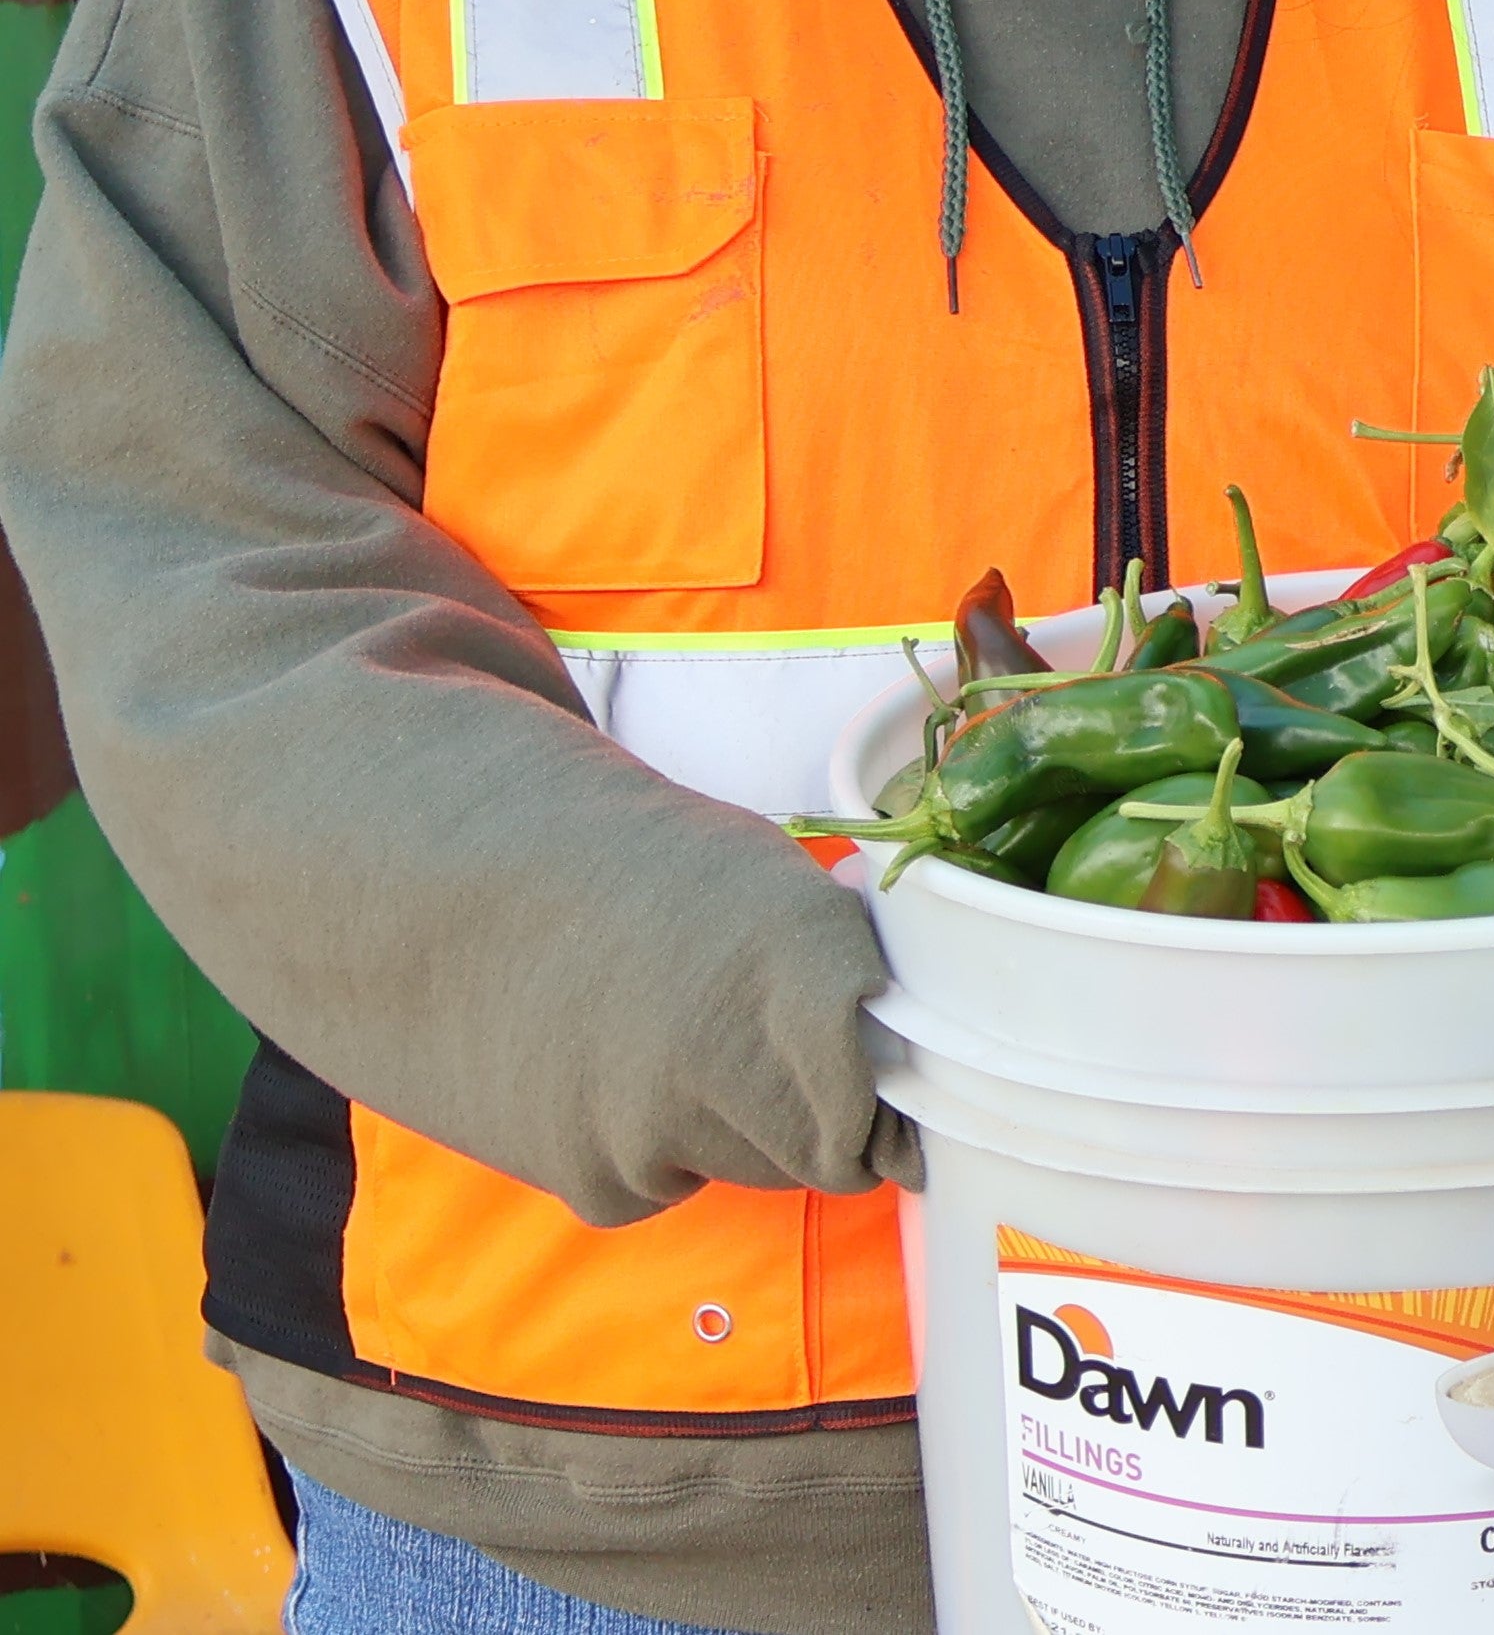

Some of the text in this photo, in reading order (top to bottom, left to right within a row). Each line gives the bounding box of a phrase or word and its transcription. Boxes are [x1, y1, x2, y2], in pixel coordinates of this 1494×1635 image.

[1021, 1414, 1143, 1481] FILLINGS
[1022, 1462, 1077, 1510] VANILLA
[1049, 1524, 1086, 1544] CREAMY
[1207, 1532, 1255, 1553] Naturally
[1259, 1540, 1278, 1553] and
[1283, 1540, 1340, 1559] Artificially
[1061, 1611, 1086, 1628] USED
[1204, 1611, 1238, 1621] YELW
